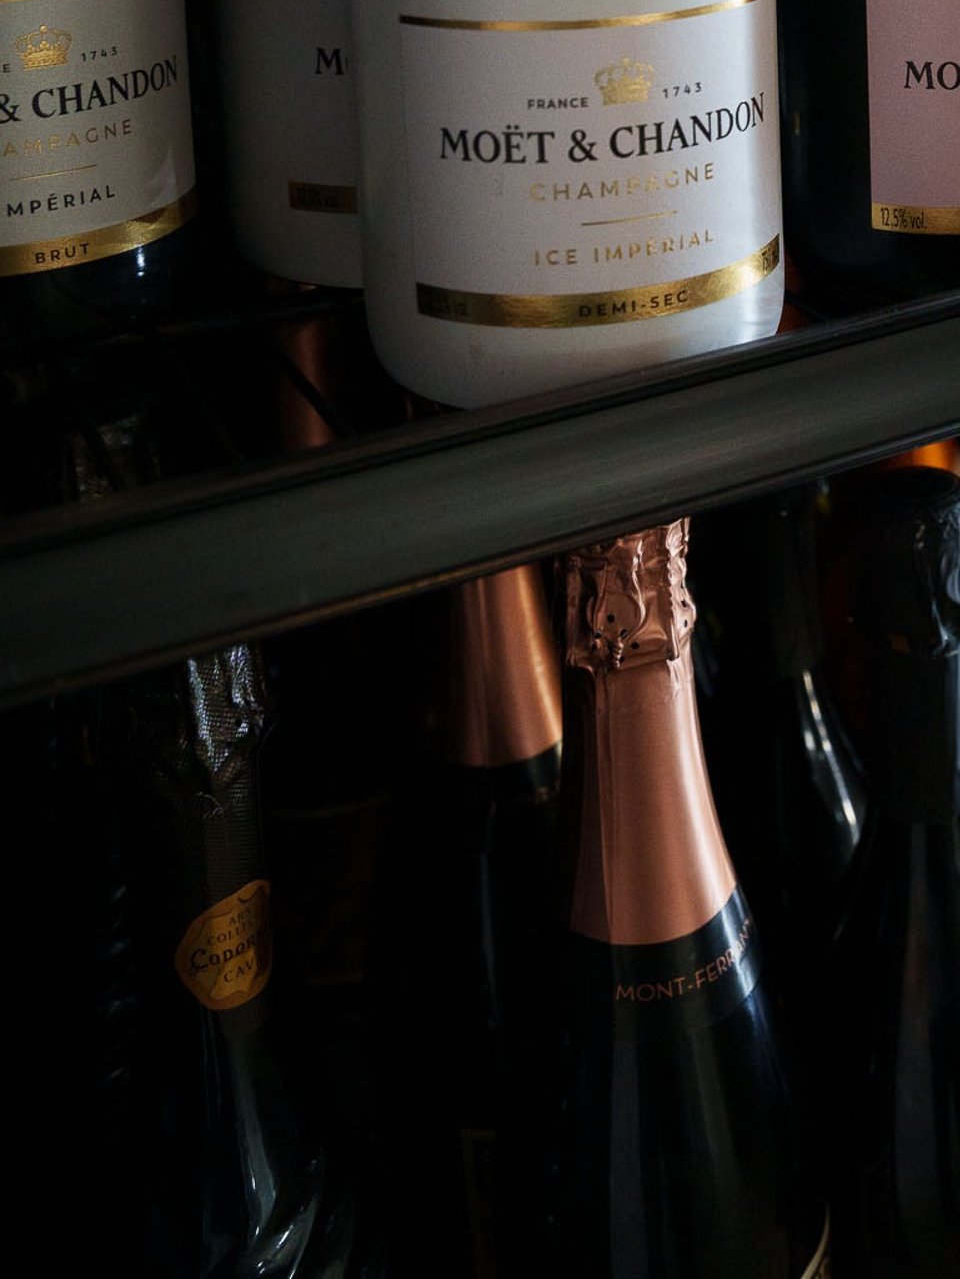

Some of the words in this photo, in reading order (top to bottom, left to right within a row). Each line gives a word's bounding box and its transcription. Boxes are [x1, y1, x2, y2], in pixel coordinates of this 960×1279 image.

[80, 46, 118, 63] 1743
[31, 54, 179, 119] CHANDON
[527, 97, 590, 110] FRANCE
[662, 82, 703, 99] 1743
[2, 118, 133, 158] AMPAGNE
[439, 124, 556, 164] MOËT
[567, 128, 598, 164] &
[609, 92, 765, 159] CHANDON
[529, 162, 716, 204] CHAMPAGNE
[6, 183, 116, 218] MPÉRIAL
[35, 242, 91, 265] BRUT
[534, 249, 578, 267] ICE
[578, 288, 690, 319] DEMI-SEC
